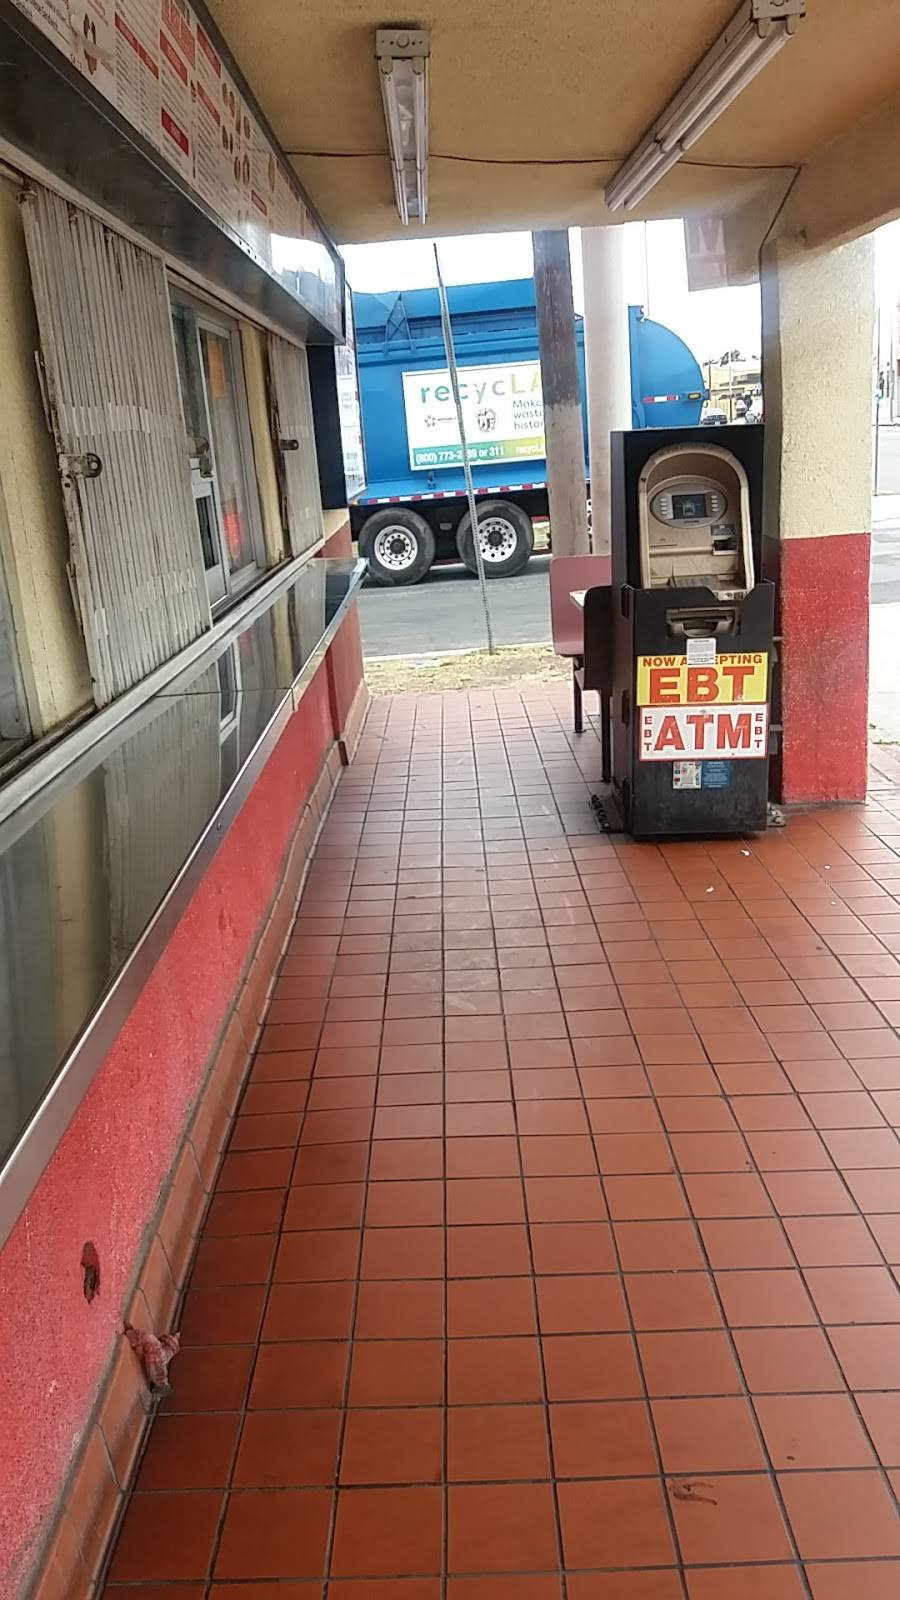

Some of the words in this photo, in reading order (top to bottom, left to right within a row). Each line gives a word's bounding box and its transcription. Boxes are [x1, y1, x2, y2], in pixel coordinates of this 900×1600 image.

[415, 452, 437, 464] (800)
[438, 449, 477, 461] 773-289
[489, 446, 504, 456] 311
[643, 657, 675, 667] NOW
[680, 654, 762, 666] APTING
[650, 666, 755, 704] EBT
[644, 716, 653, 751] EBT
[654, 713, 752, 751] ATM
[754, 713, 763, 748] EBT
